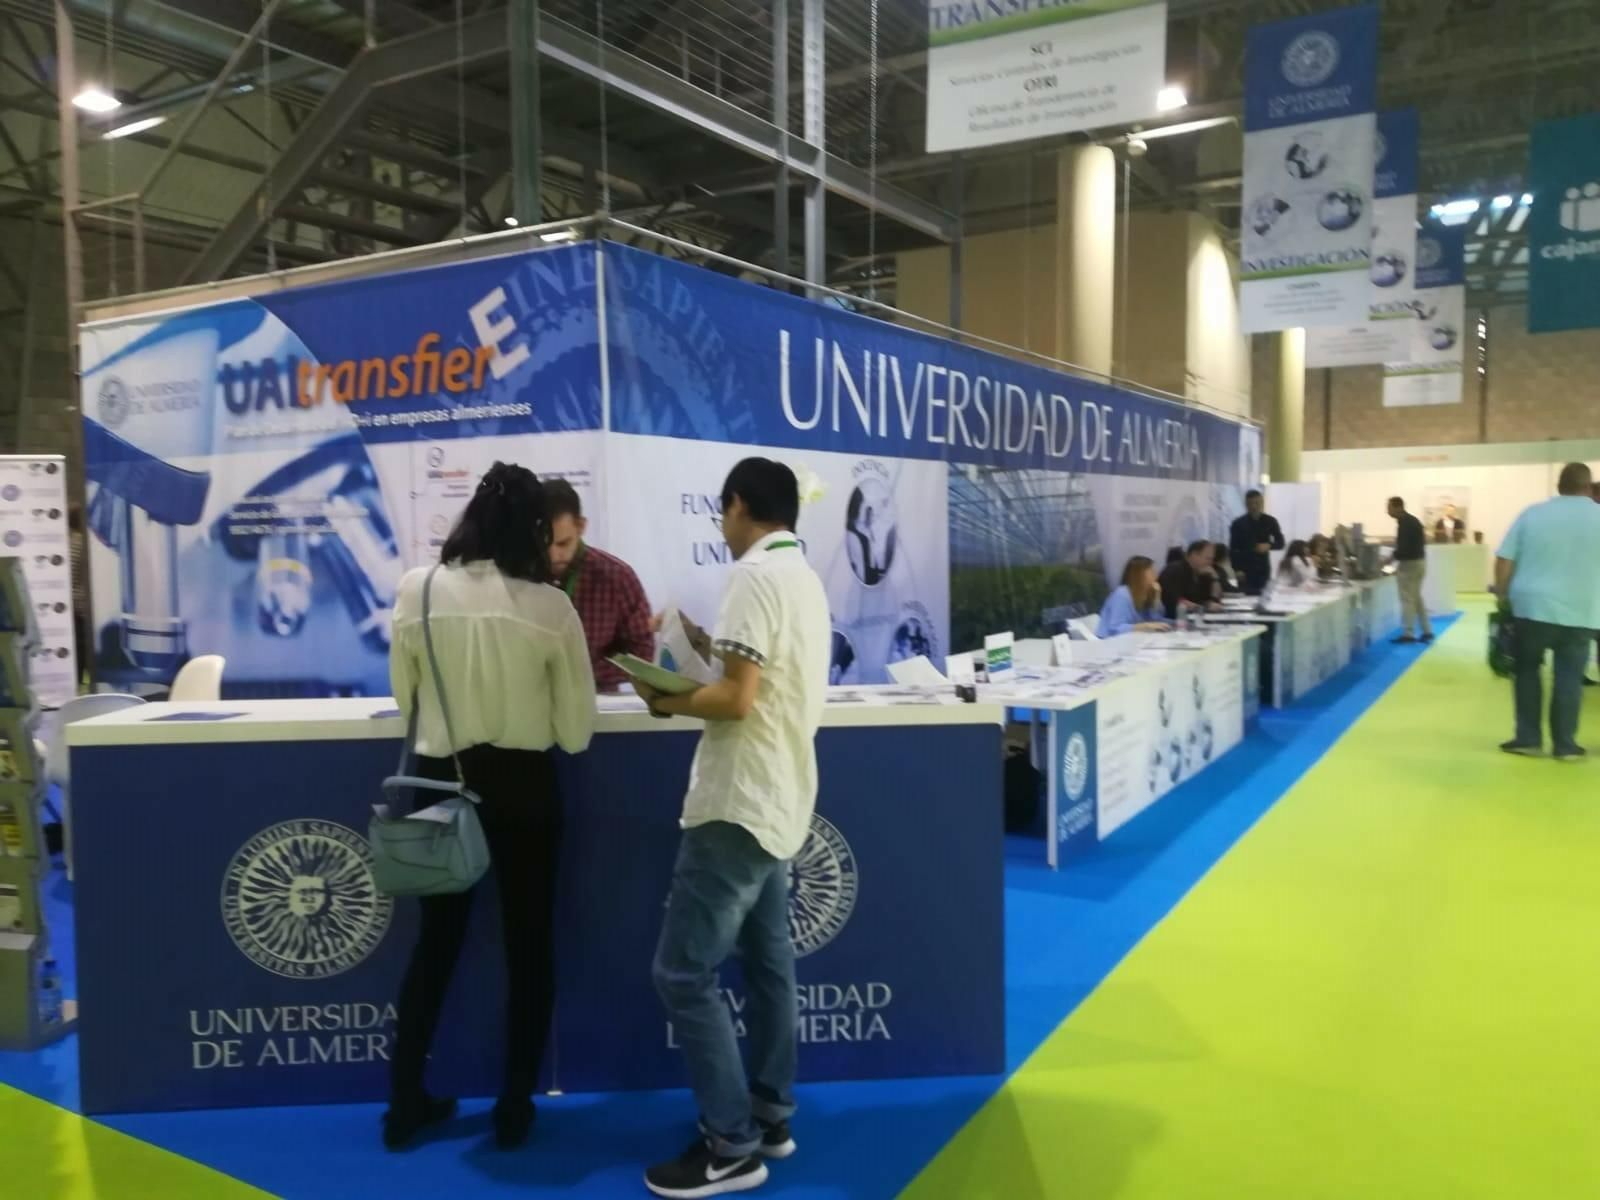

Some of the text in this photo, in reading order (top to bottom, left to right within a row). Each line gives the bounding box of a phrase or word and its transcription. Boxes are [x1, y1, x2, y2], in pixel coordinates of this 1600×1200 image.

[392, 406, 450, 427] empresas
[451, 402, 532, 423] almerienses
[780, 329, 1200, 470] UNIVERSIDAD DE ALMERÍA
[189, 1002, 398, 1036] UNIVERSIDA
[191, 1032, 397, 1069] DE ALMER
